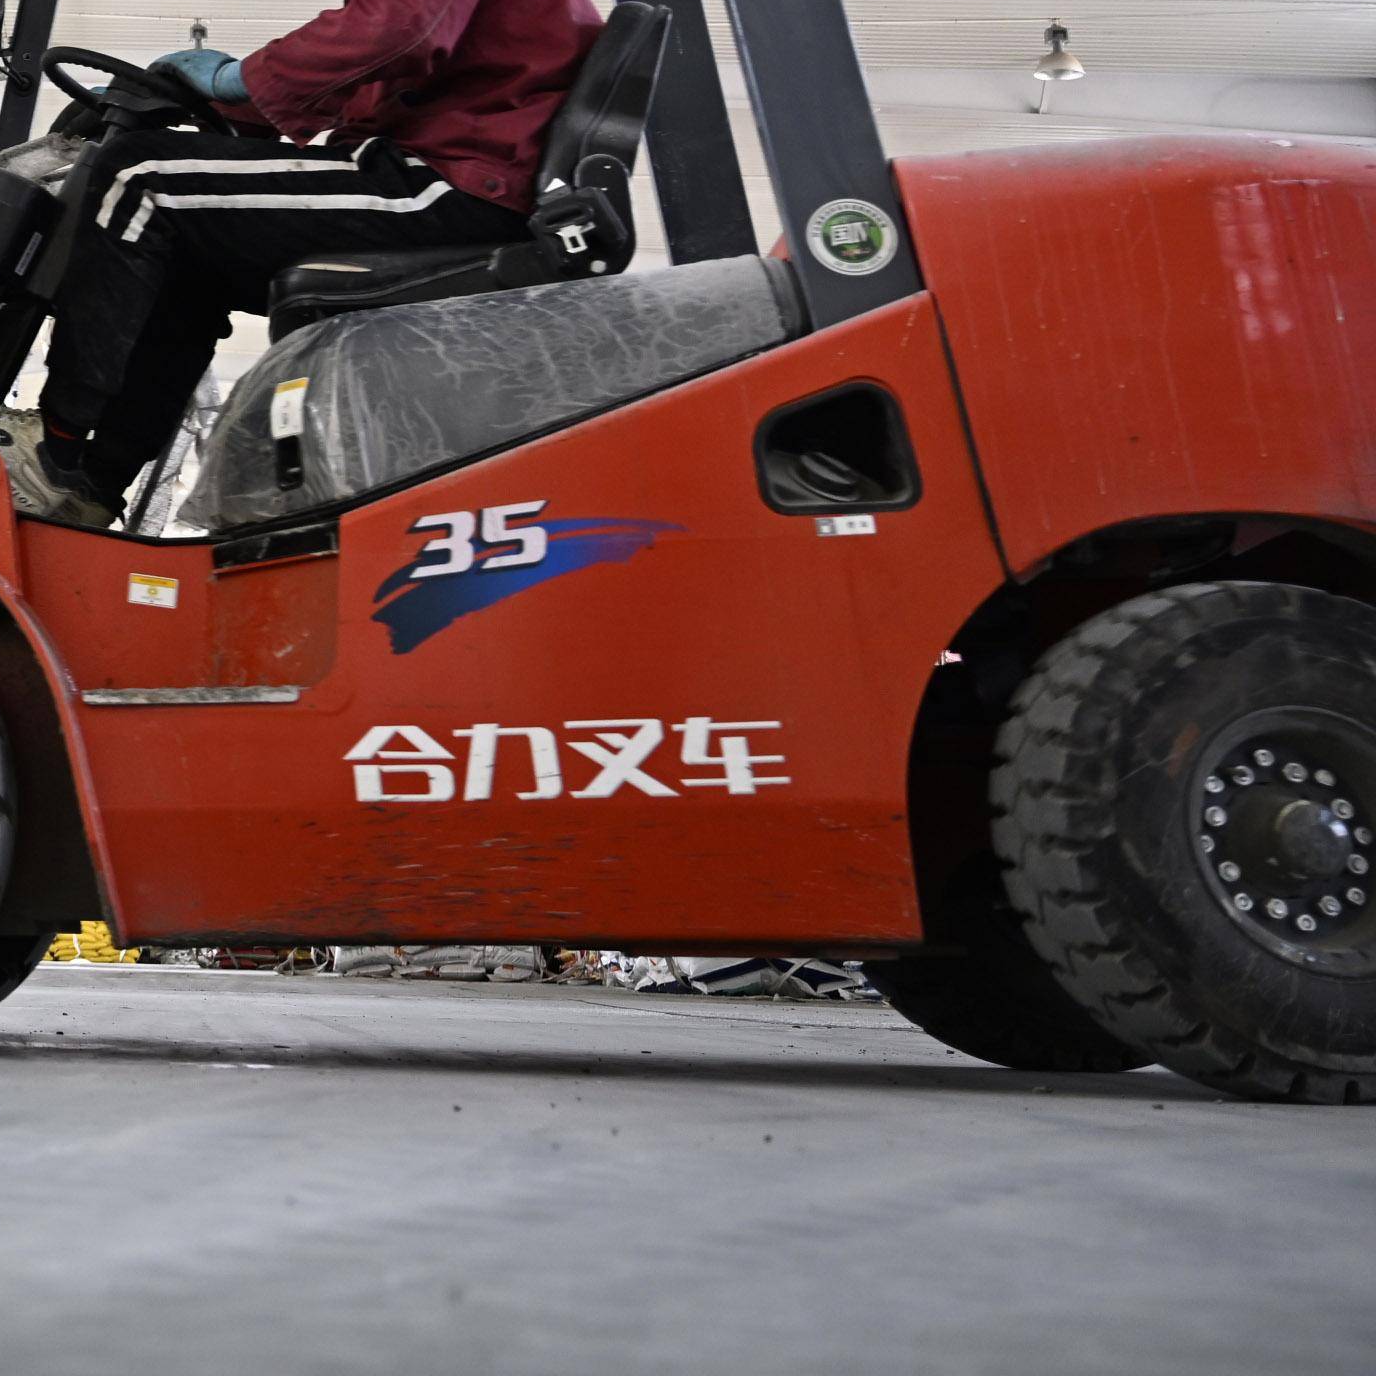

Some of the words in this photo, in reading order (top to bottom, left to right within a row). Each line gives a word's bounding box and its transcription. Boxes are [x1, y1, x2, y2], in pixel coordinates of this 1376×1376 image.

[408, 500, 547, 579] 35
[342, 717, 791, 802] 合力叉车
